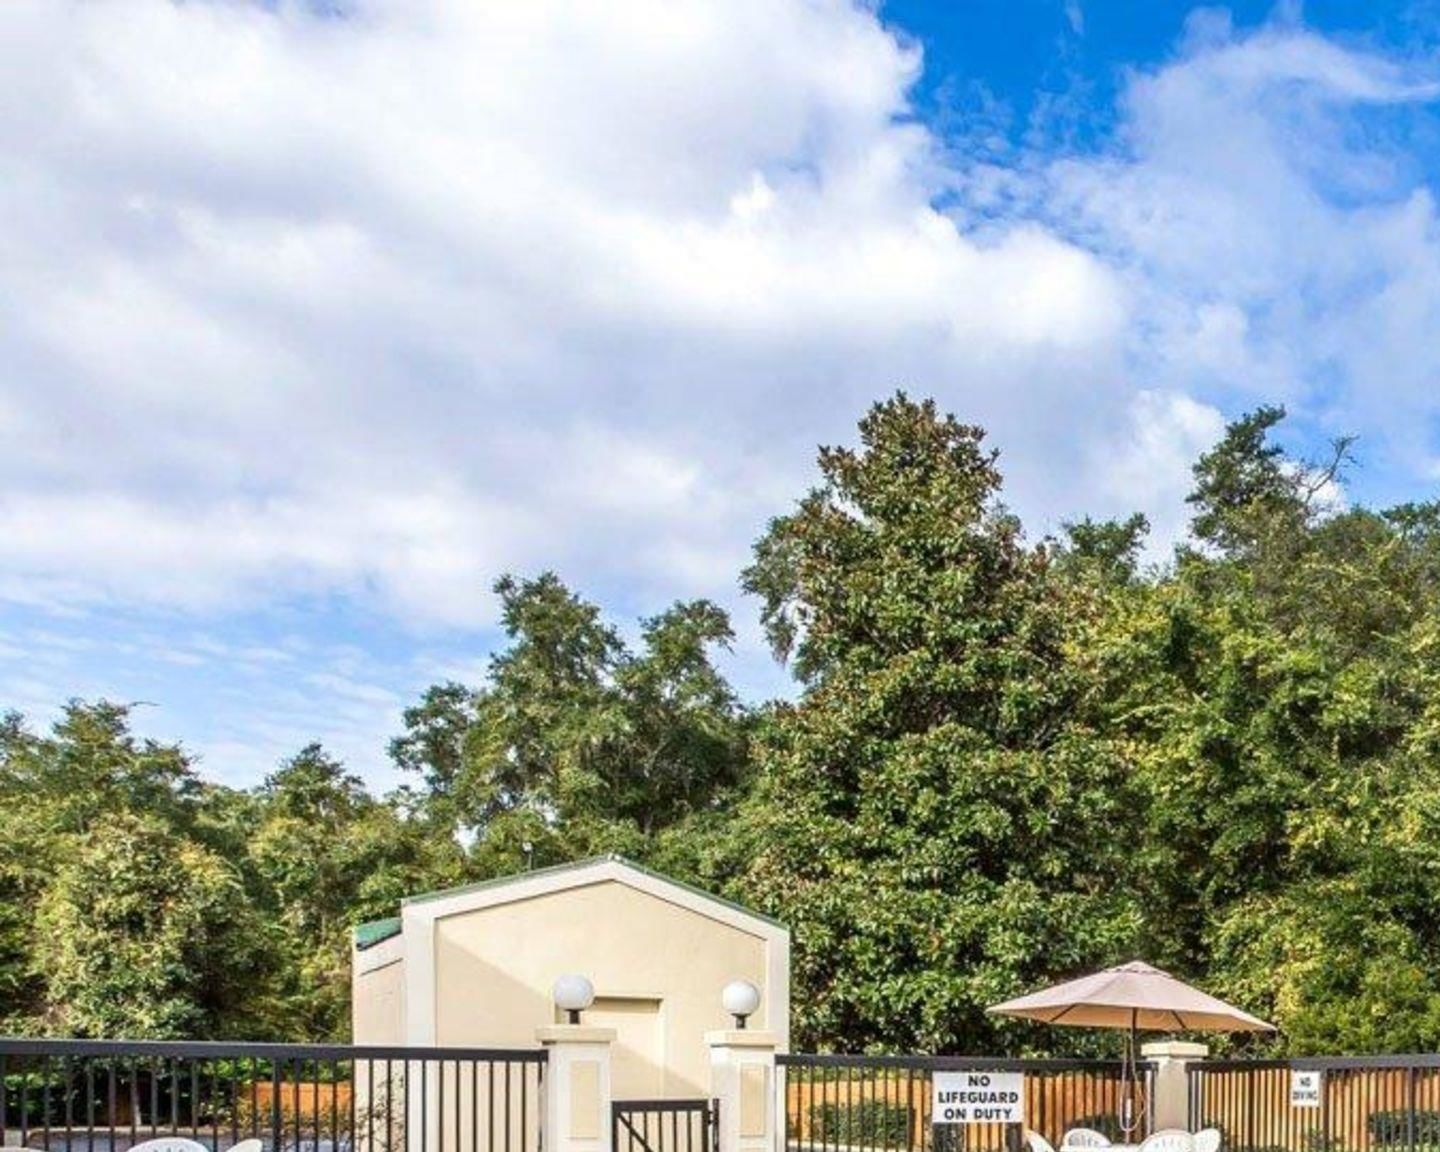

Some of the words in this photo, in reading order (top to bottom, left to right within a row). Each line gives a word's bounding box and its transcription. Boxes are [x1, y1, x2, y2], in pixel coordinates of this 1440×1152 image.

[968, 1075, 991, 1087] NO
[1299, 1077, 1312, 1087] NO
[938, 1092, 1019, 1103] LIFEGUARD
[944, 1109, 966, 1120] ON
[974, 1109, 1012, 1120] DUTY
